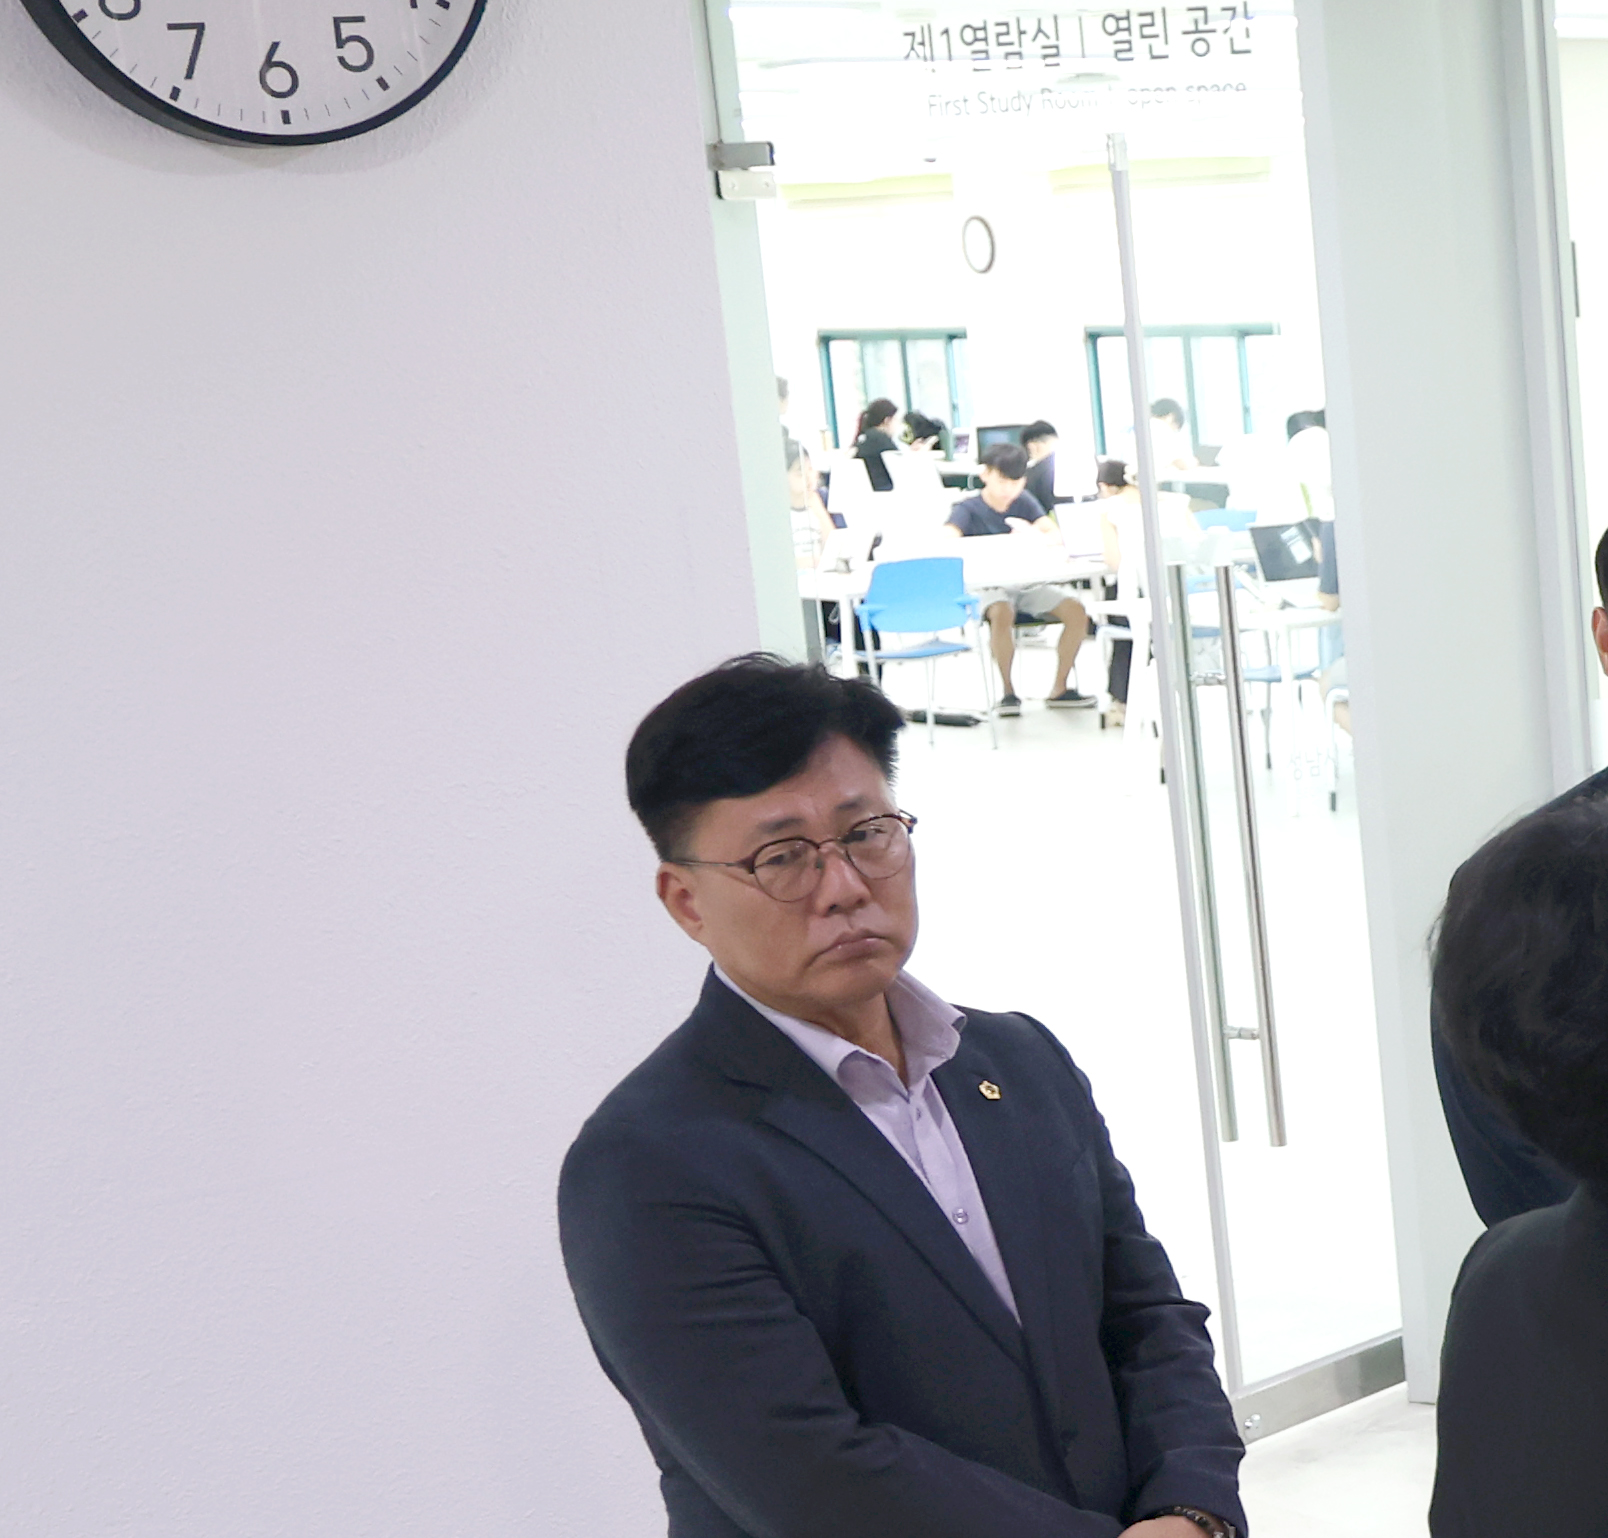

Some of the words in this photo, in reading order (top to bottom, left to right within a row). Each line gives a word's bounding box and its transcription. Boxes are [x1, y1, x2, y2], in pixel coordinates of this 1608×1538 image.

[166, 22, 206, 80] 7
[332, 16, 375, 74] 5
[901, 13, 1063, 73] 제1열람실
[1101, 6, 1171, 62] 열린
[1180, 1, 1254, 58] 공간
[258, 41, 299, 99] 6
[927, 93, 972, 118] First
[977, 90, 1034, 118] Study
